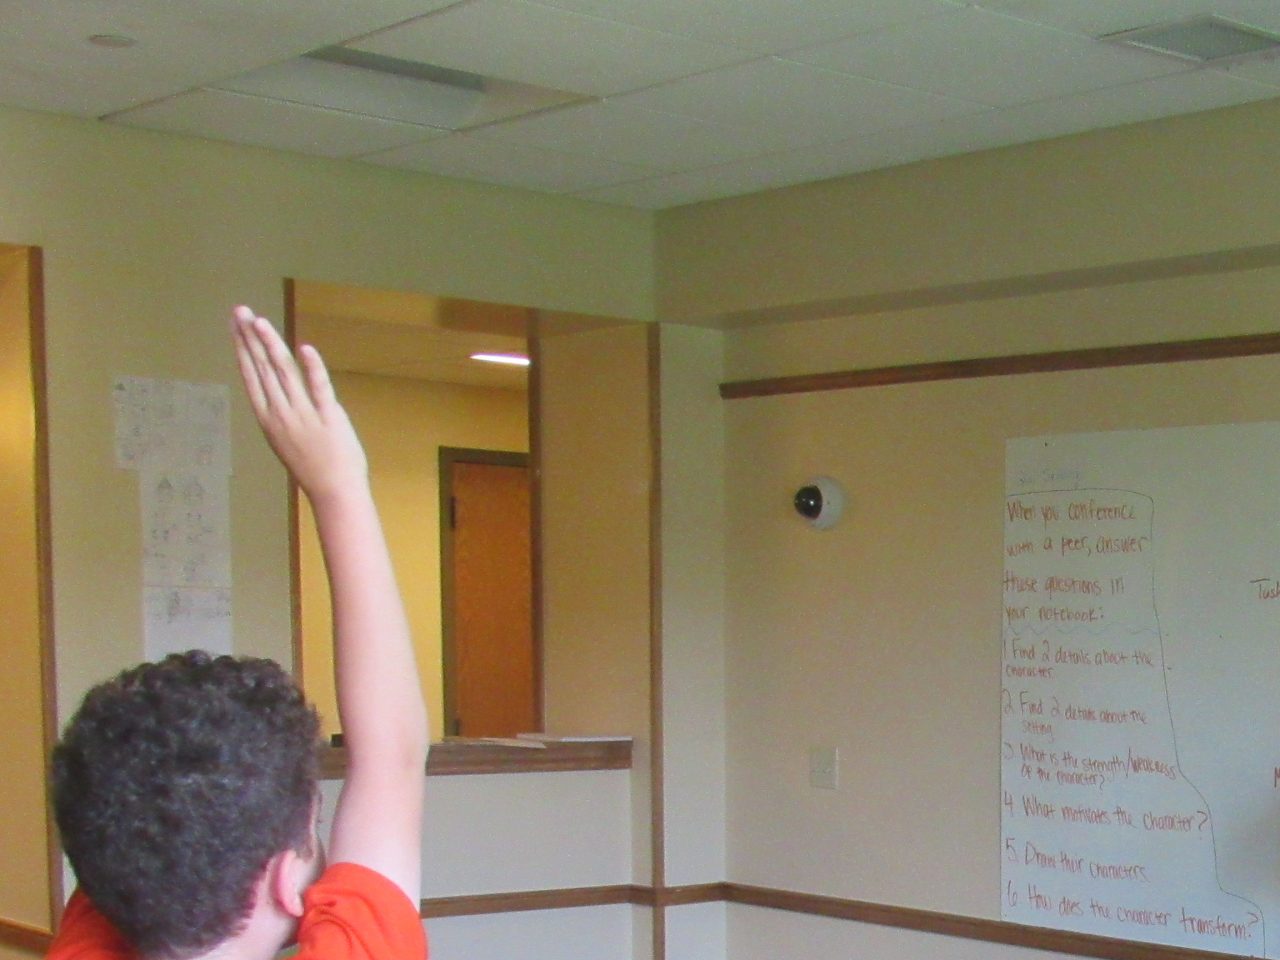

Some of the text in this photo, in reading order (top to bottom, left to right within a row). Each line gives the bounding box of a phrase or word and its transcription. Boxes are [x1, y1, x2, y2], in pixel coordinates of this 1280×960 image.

[1007, 499, 1136, 531] When you conference
[1043, 536, 1053, 550] a
[1096, 536, 1148, 553] answer
[1111, 576, 1124, 595] in
[1005, 606, 1030, 625] your
[1012, 638, 1036, 660] Find
[1055, 645, 1092, 665] details
[1095, 648, 1128, 665] about
[1019, 691, 1043, 715] Find
